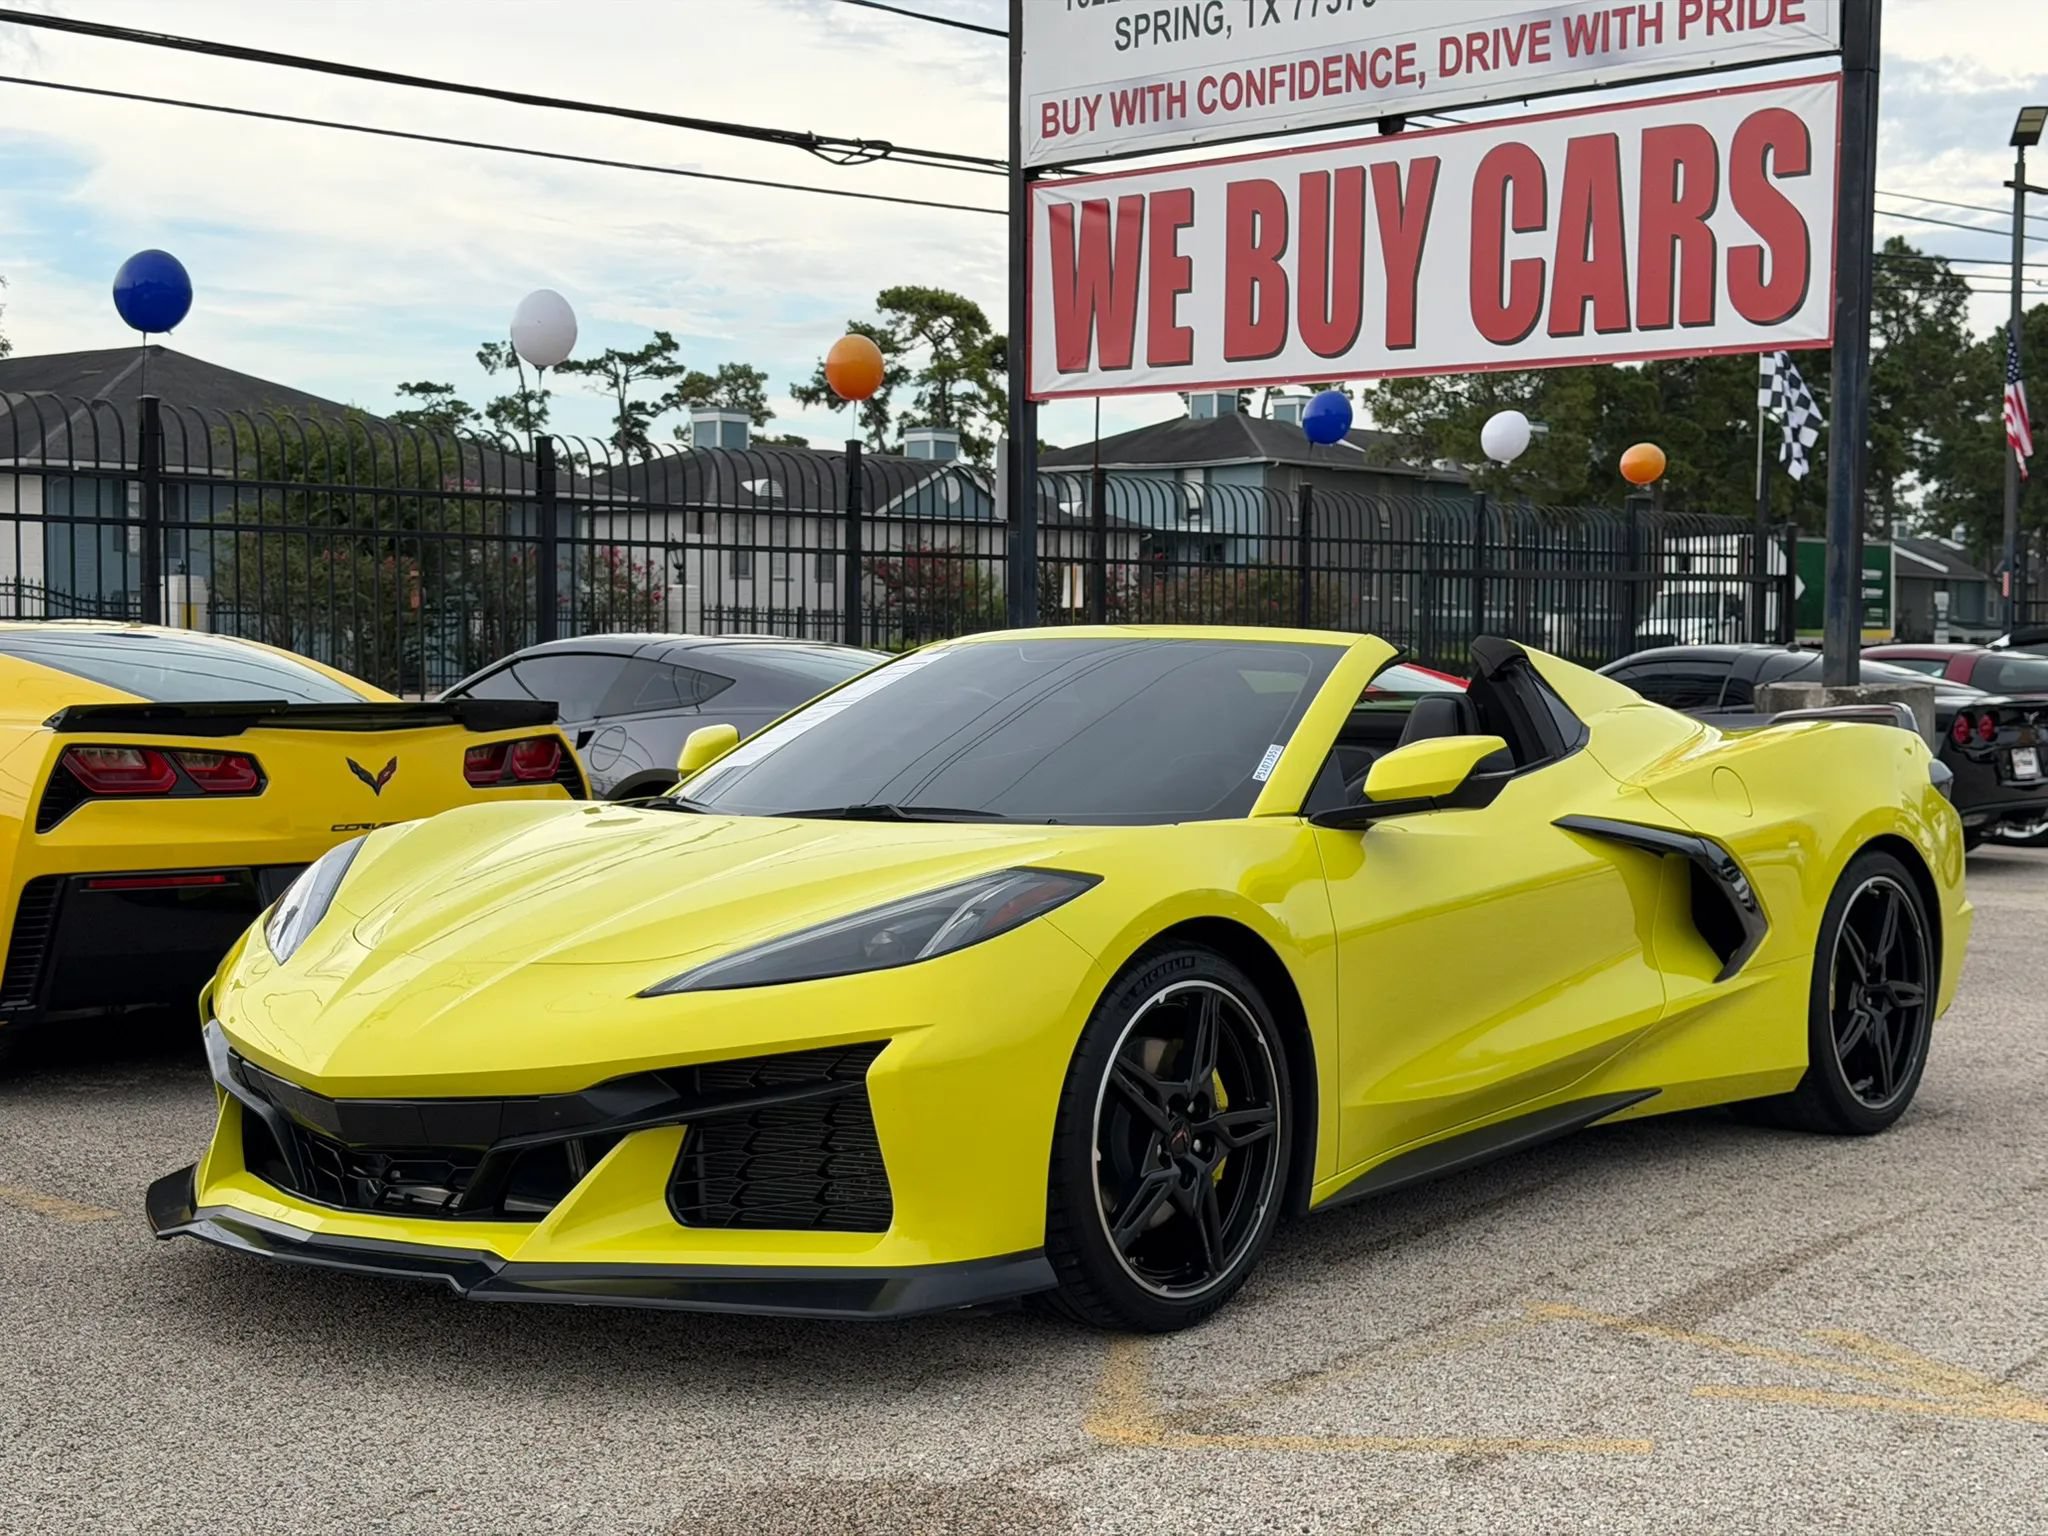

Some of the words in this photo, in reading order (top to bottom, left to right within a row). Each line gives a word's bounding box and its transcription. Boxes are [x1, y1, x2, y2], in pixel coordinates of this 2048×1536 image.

[1041, 94, 1102, 139] BUY
[1110, 81, 1186, 128] WITH
[1196, 42, 1425, 115] CONFIDENCE,
[1439, 20, 1551, 78] DRIVE
[1562, 7, 1664, 58] WITH
[1678, 0, 1806, 40] PRIDE
[1114, 0, 1231, 51] SPRING,
[1048, 187, 1195, 375] WE
[1223, 155, 1442, 363] BUY
[1469, 106, 1812, 346] CARS
